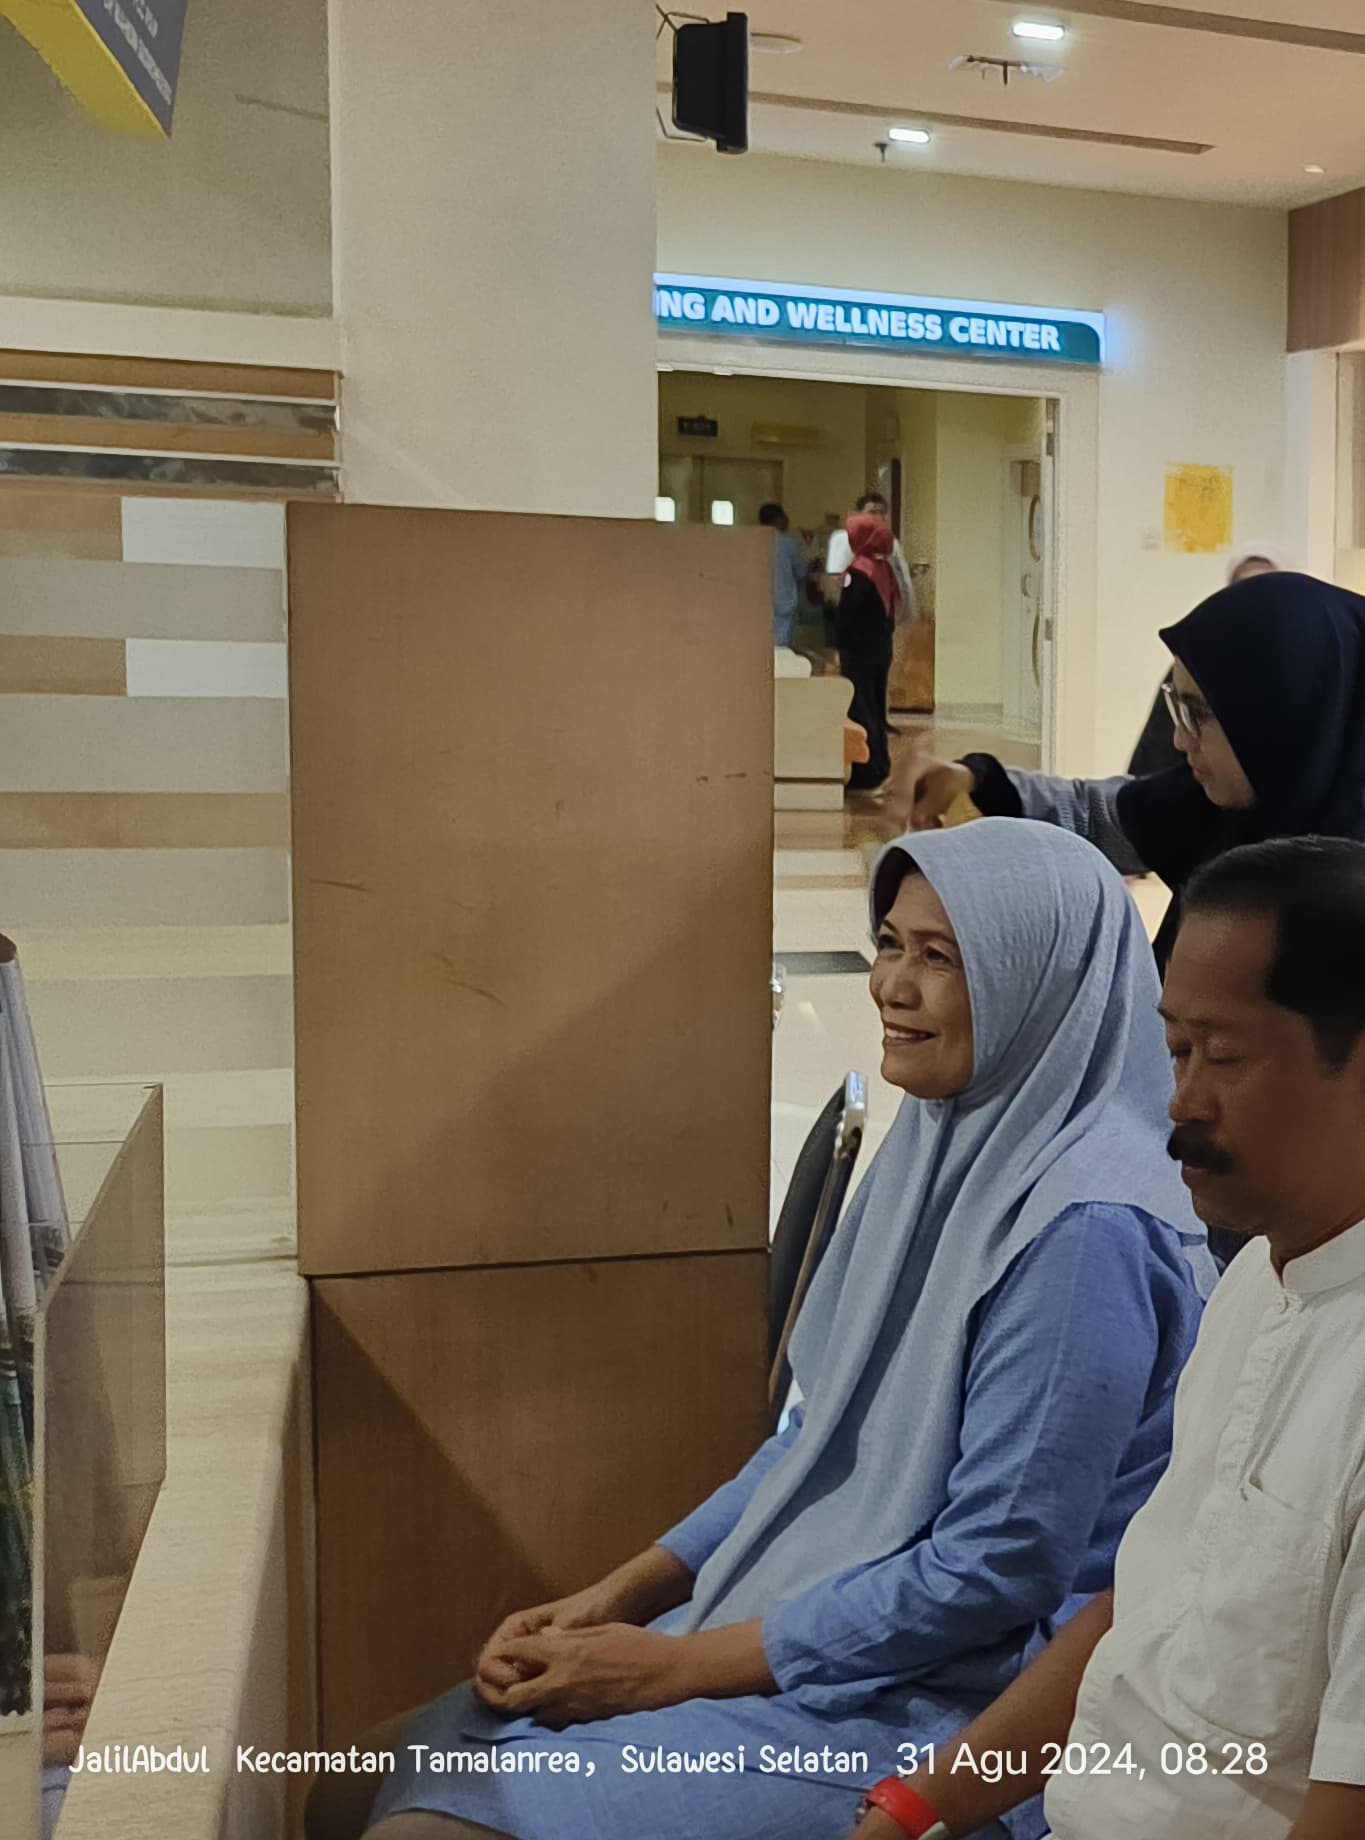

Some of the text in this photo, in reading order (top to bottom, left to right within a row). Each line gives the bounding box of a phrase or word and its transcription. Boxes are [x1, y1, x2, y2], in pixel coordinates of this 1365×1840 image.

[711, 294, 781, 327] AND
[786, 301, 943, 341] WELLNESS
[949, 316, 1061, 351] CENTER
